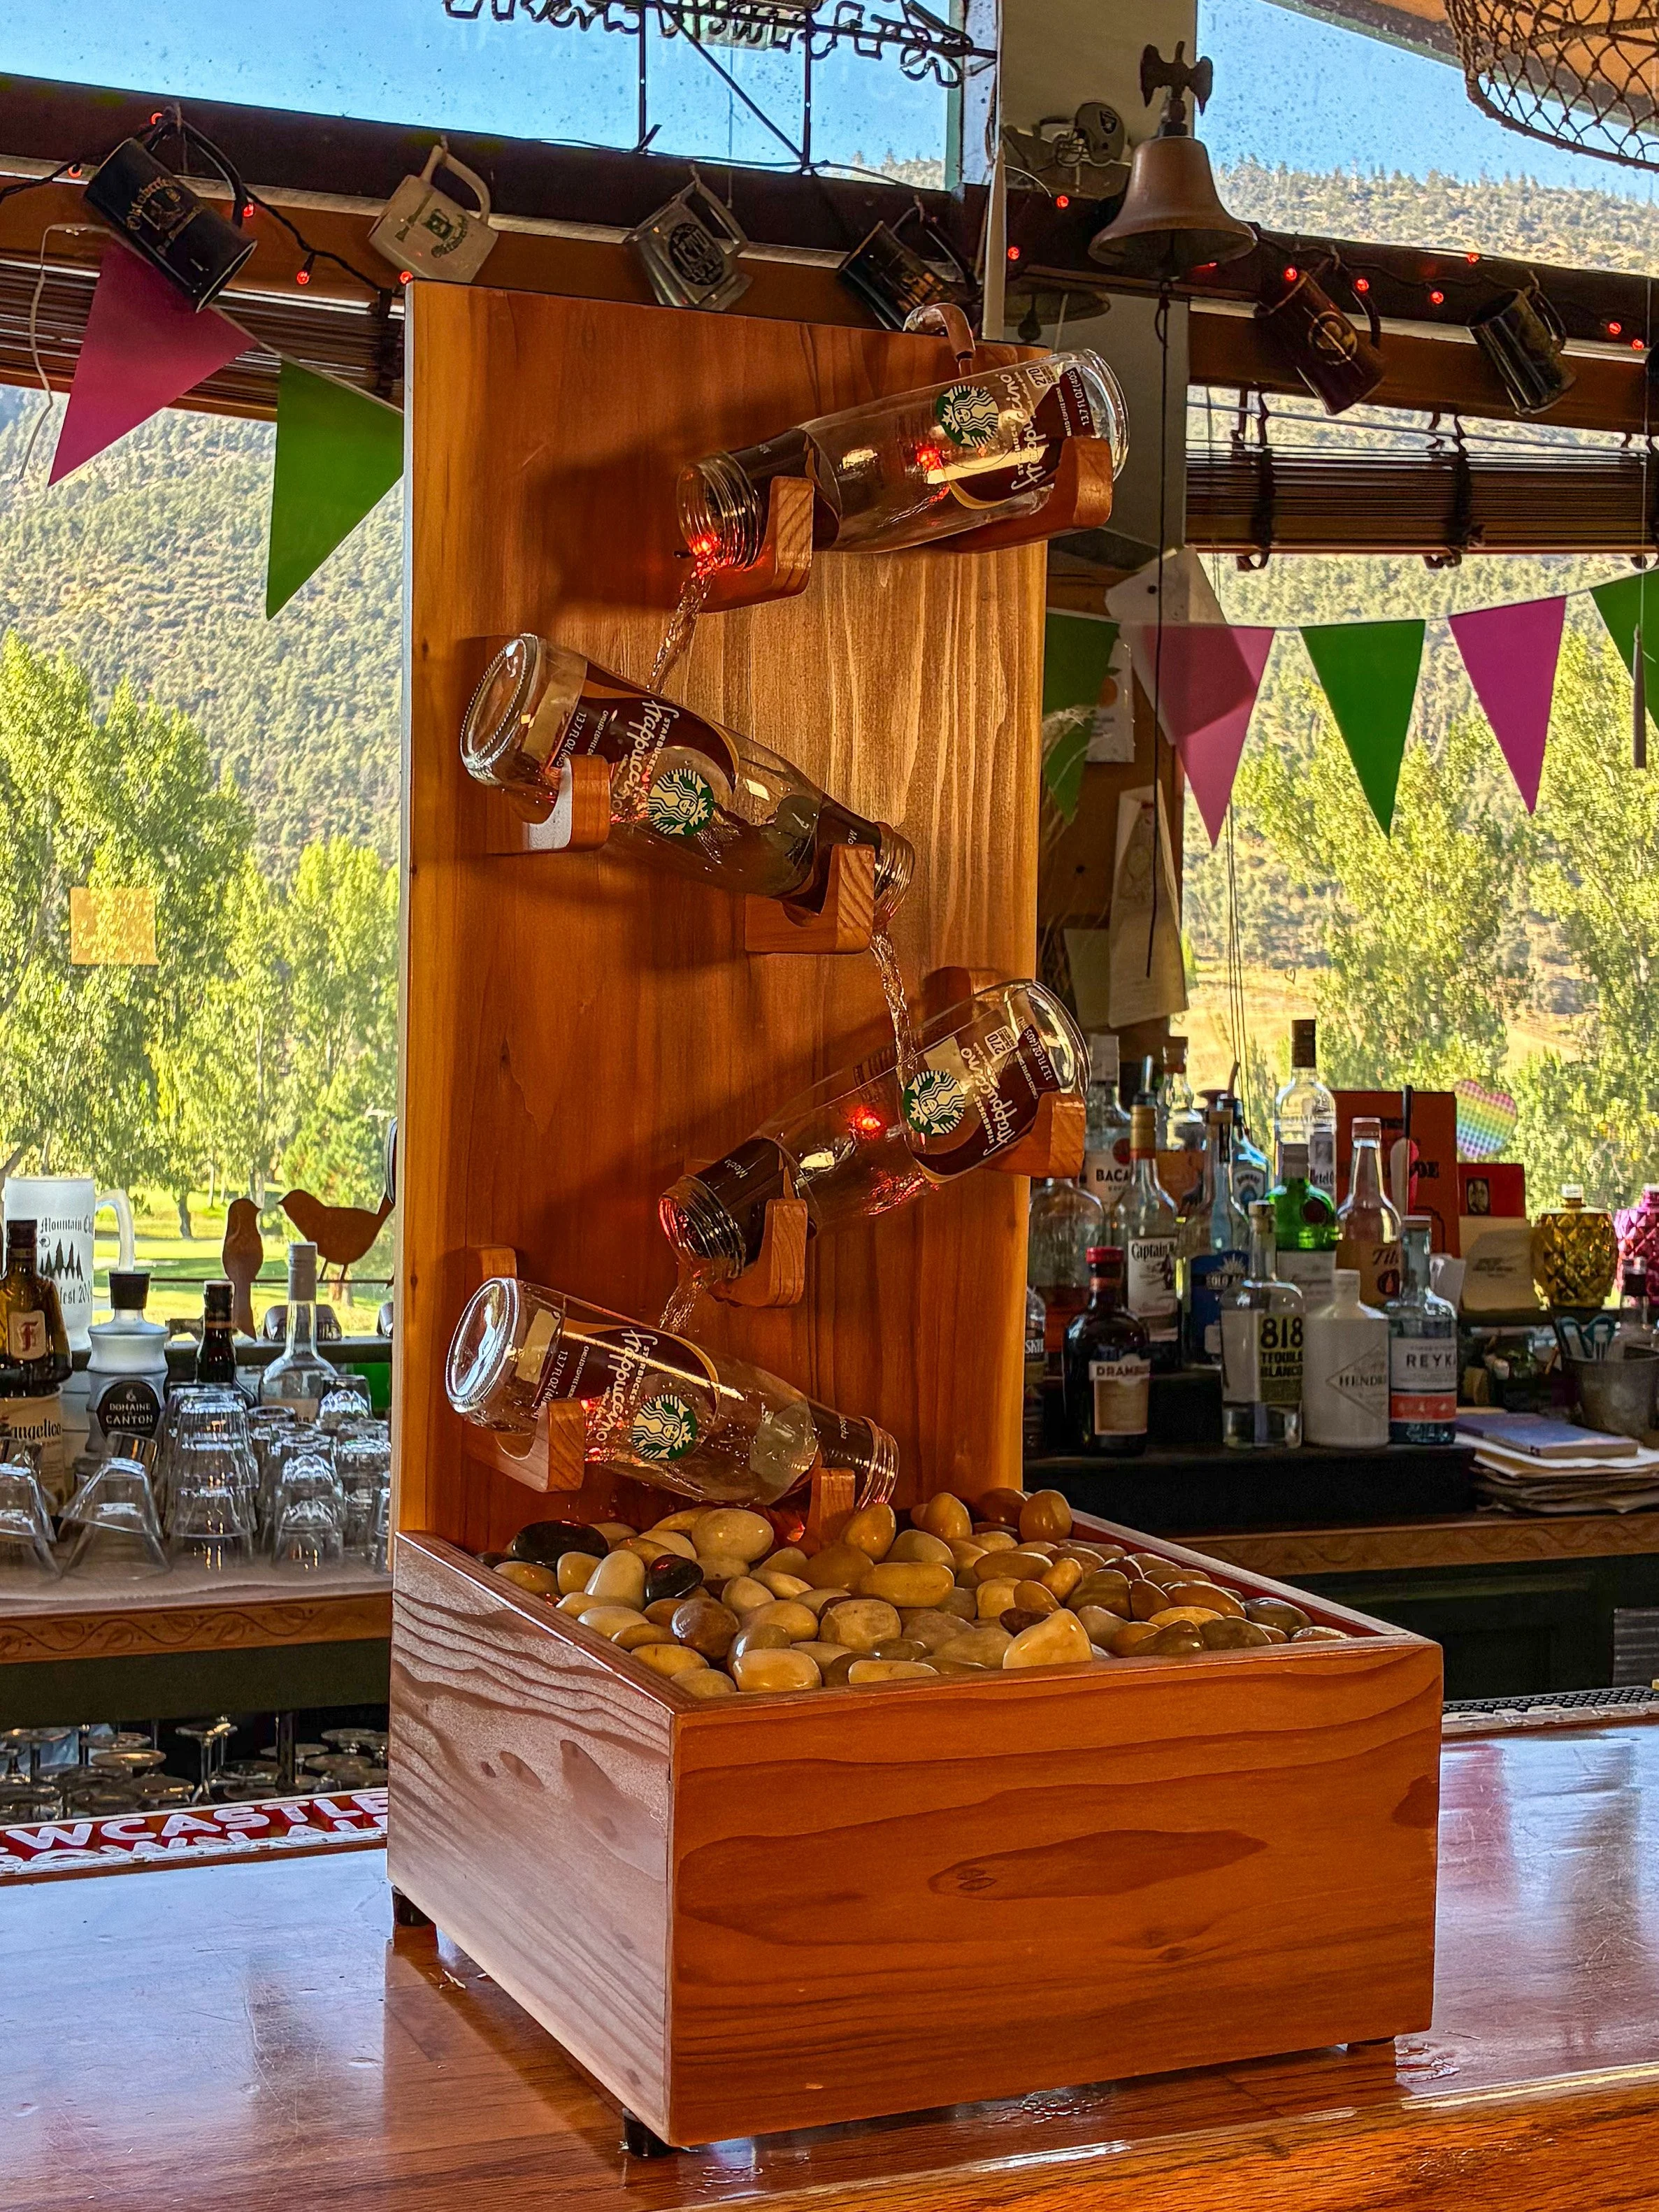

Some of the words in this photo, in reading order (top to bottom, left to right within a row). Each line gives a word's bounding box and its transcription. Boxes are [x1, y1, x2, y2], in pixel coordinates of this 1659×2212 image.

[1028, 368, 1047, 386] 270
[1072, 387, 1084, 399] OZ
[1076, 398, 1086, 408] FL
[1079, 408, 1090, 426] 13.7
[573, 711, 587, 730] 13.7
[568, 728, 580, 739] FL
[564, 738, 576, 750] OZ
[646, 717, 671, 773] STARBUCKS
[986, 1033, 1006, 1055] 270
[1032, 1044, 1044, 1057] OZ
[1040, 1063, 1054, 1081] 13.7
[974, 1095, 995, 1144] STARBUCKS
[1096, 1168, 1130, 1183] BACA
[40, 1217, 82, 1233] Mountain
[22, 1321, 38, 1351] F
[1261, 1317, 1303, 1349] 818
[555, 1349, 568, 1367] 13.7
[1261, 1351, 1303, 1364] TEQUILA
[552, 1367, 562, 1378] FL
[1261, 1365, 1303, 1377] BLANCO
[547, 1376, 559, 1388] OZ
[109, 1403, 150, 1412] DOMAINE
[106, 1414, 153, 1425] CANTON
